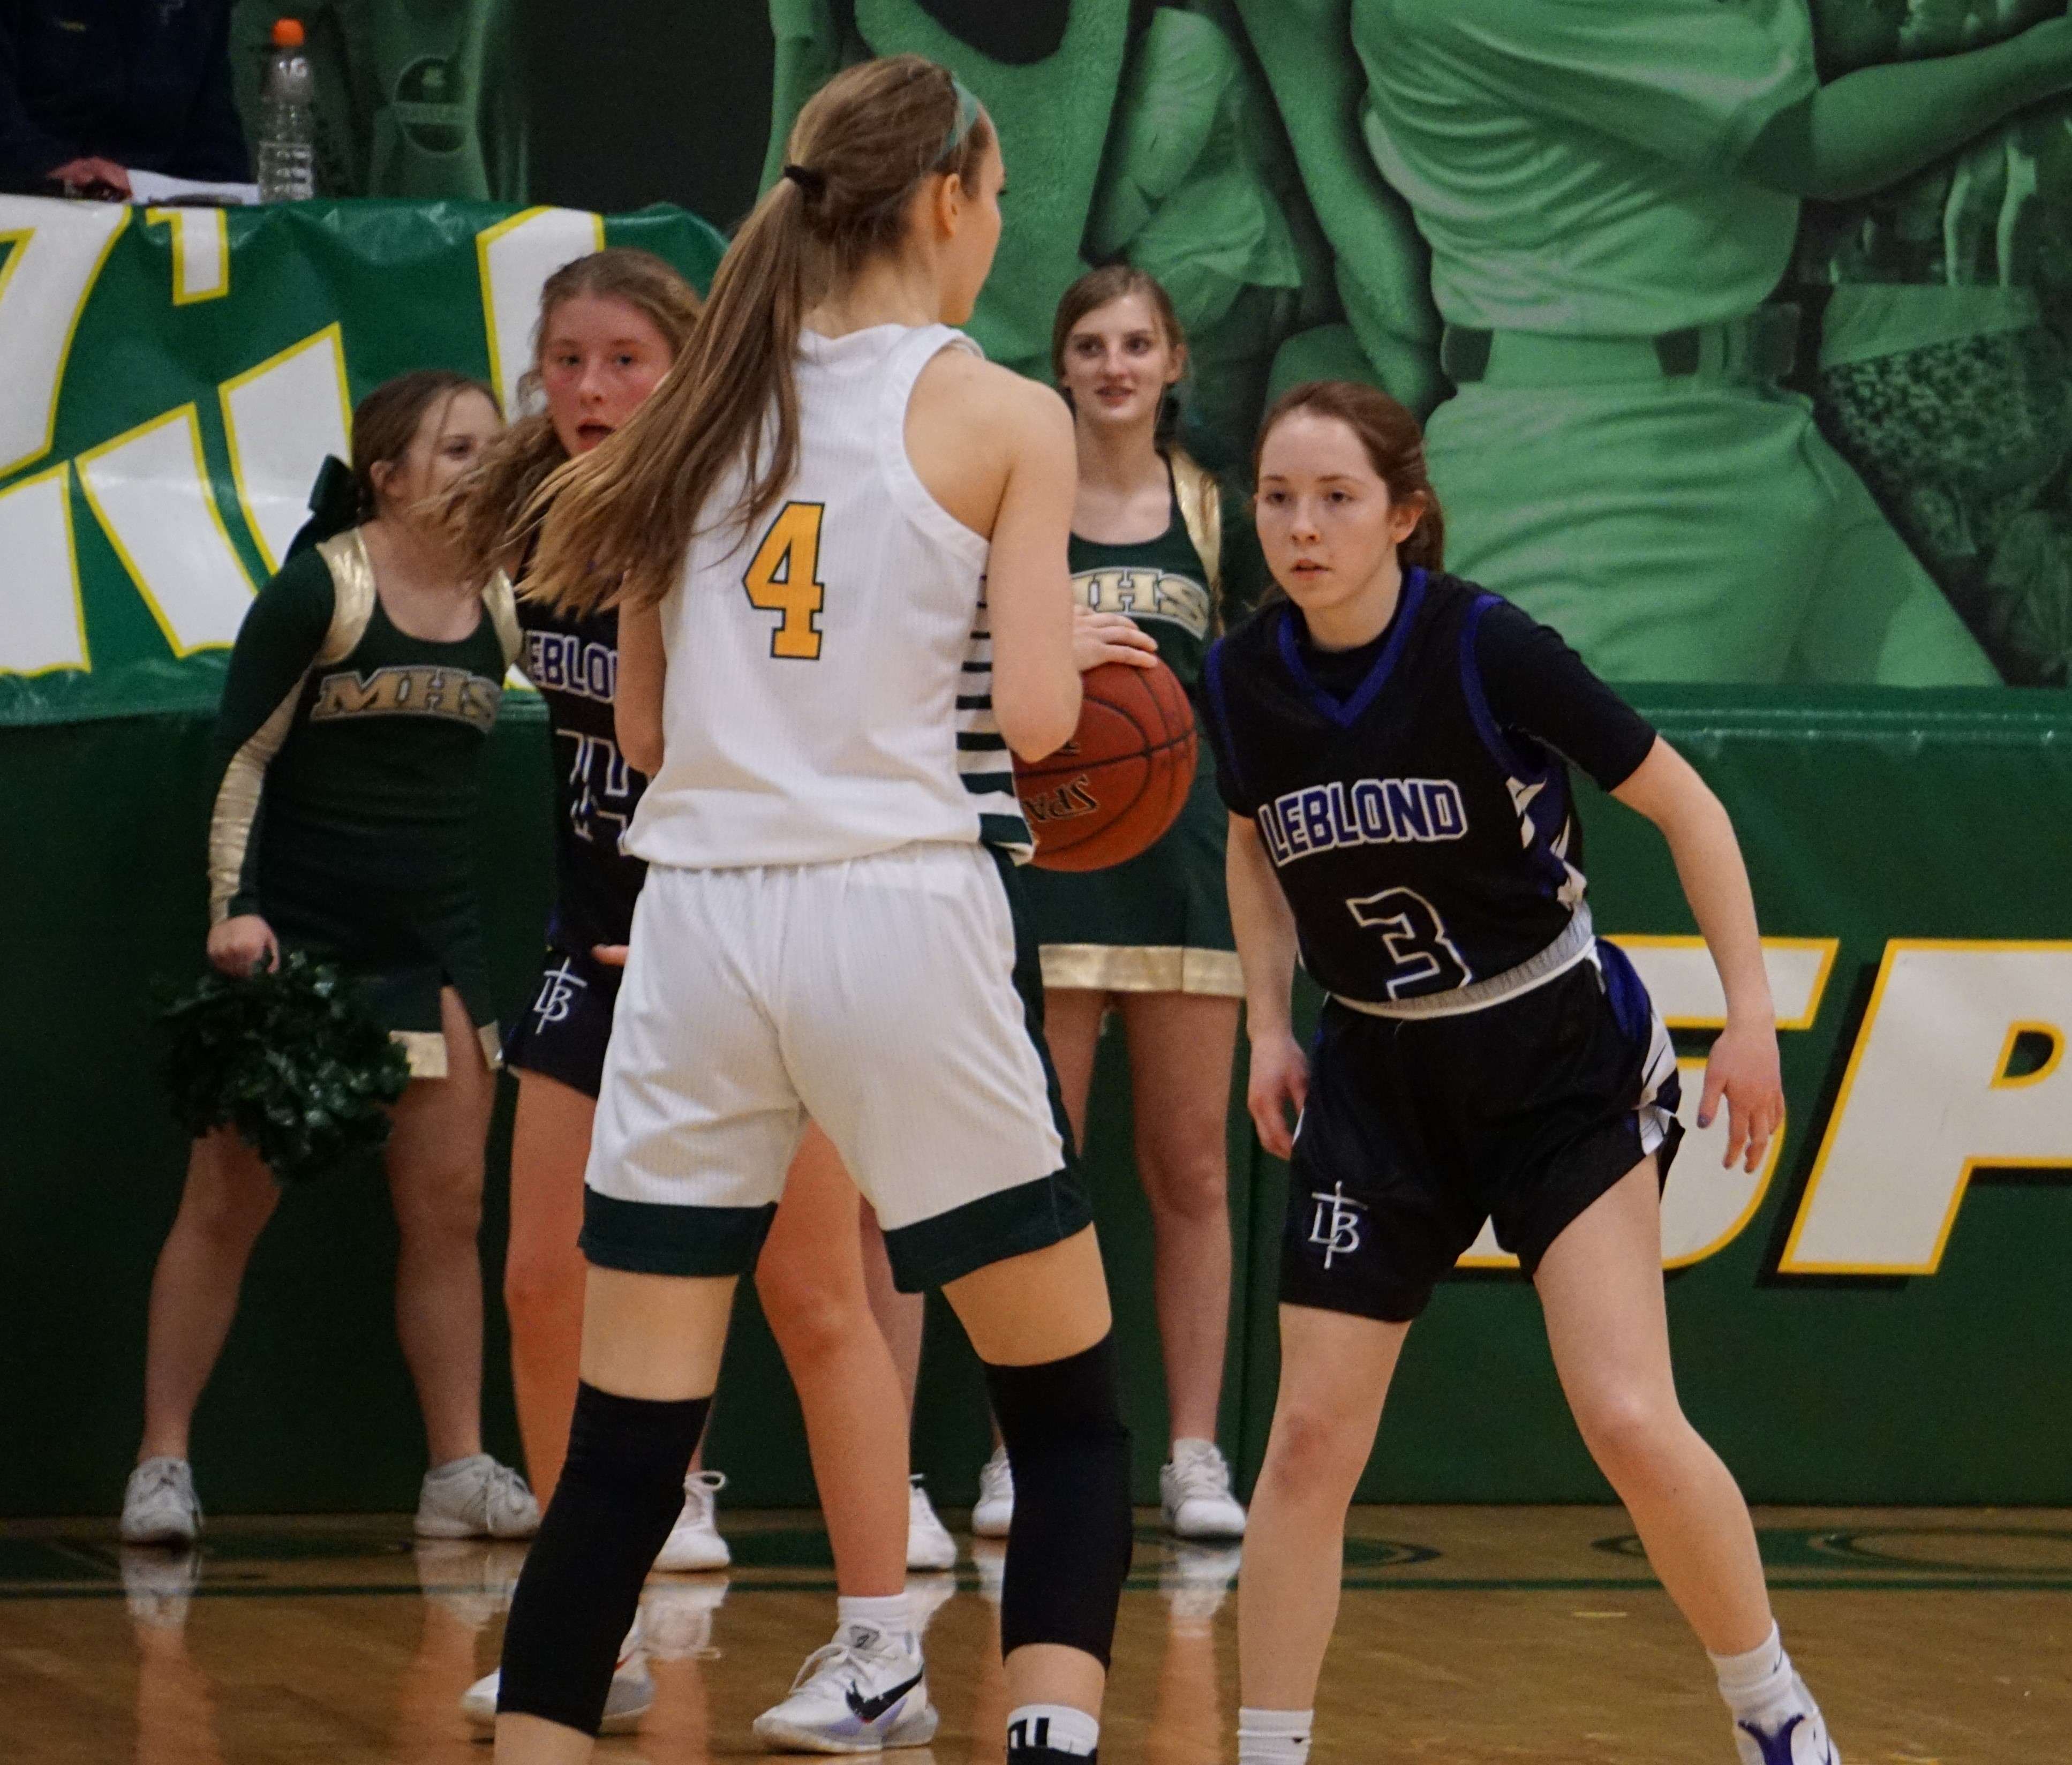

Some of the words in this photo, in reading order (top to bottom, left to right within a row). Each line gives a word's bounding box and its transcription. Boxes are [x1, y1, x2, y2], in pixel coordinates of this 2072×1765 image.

[742, 501, 825, 661] 4
[310, 665, 502, 734] MHS
[526, 630, 617, 704] EBLO
[1258, 778, 1468, 867] LEBLOND
[1346, 887, 1473, 1000] 3
